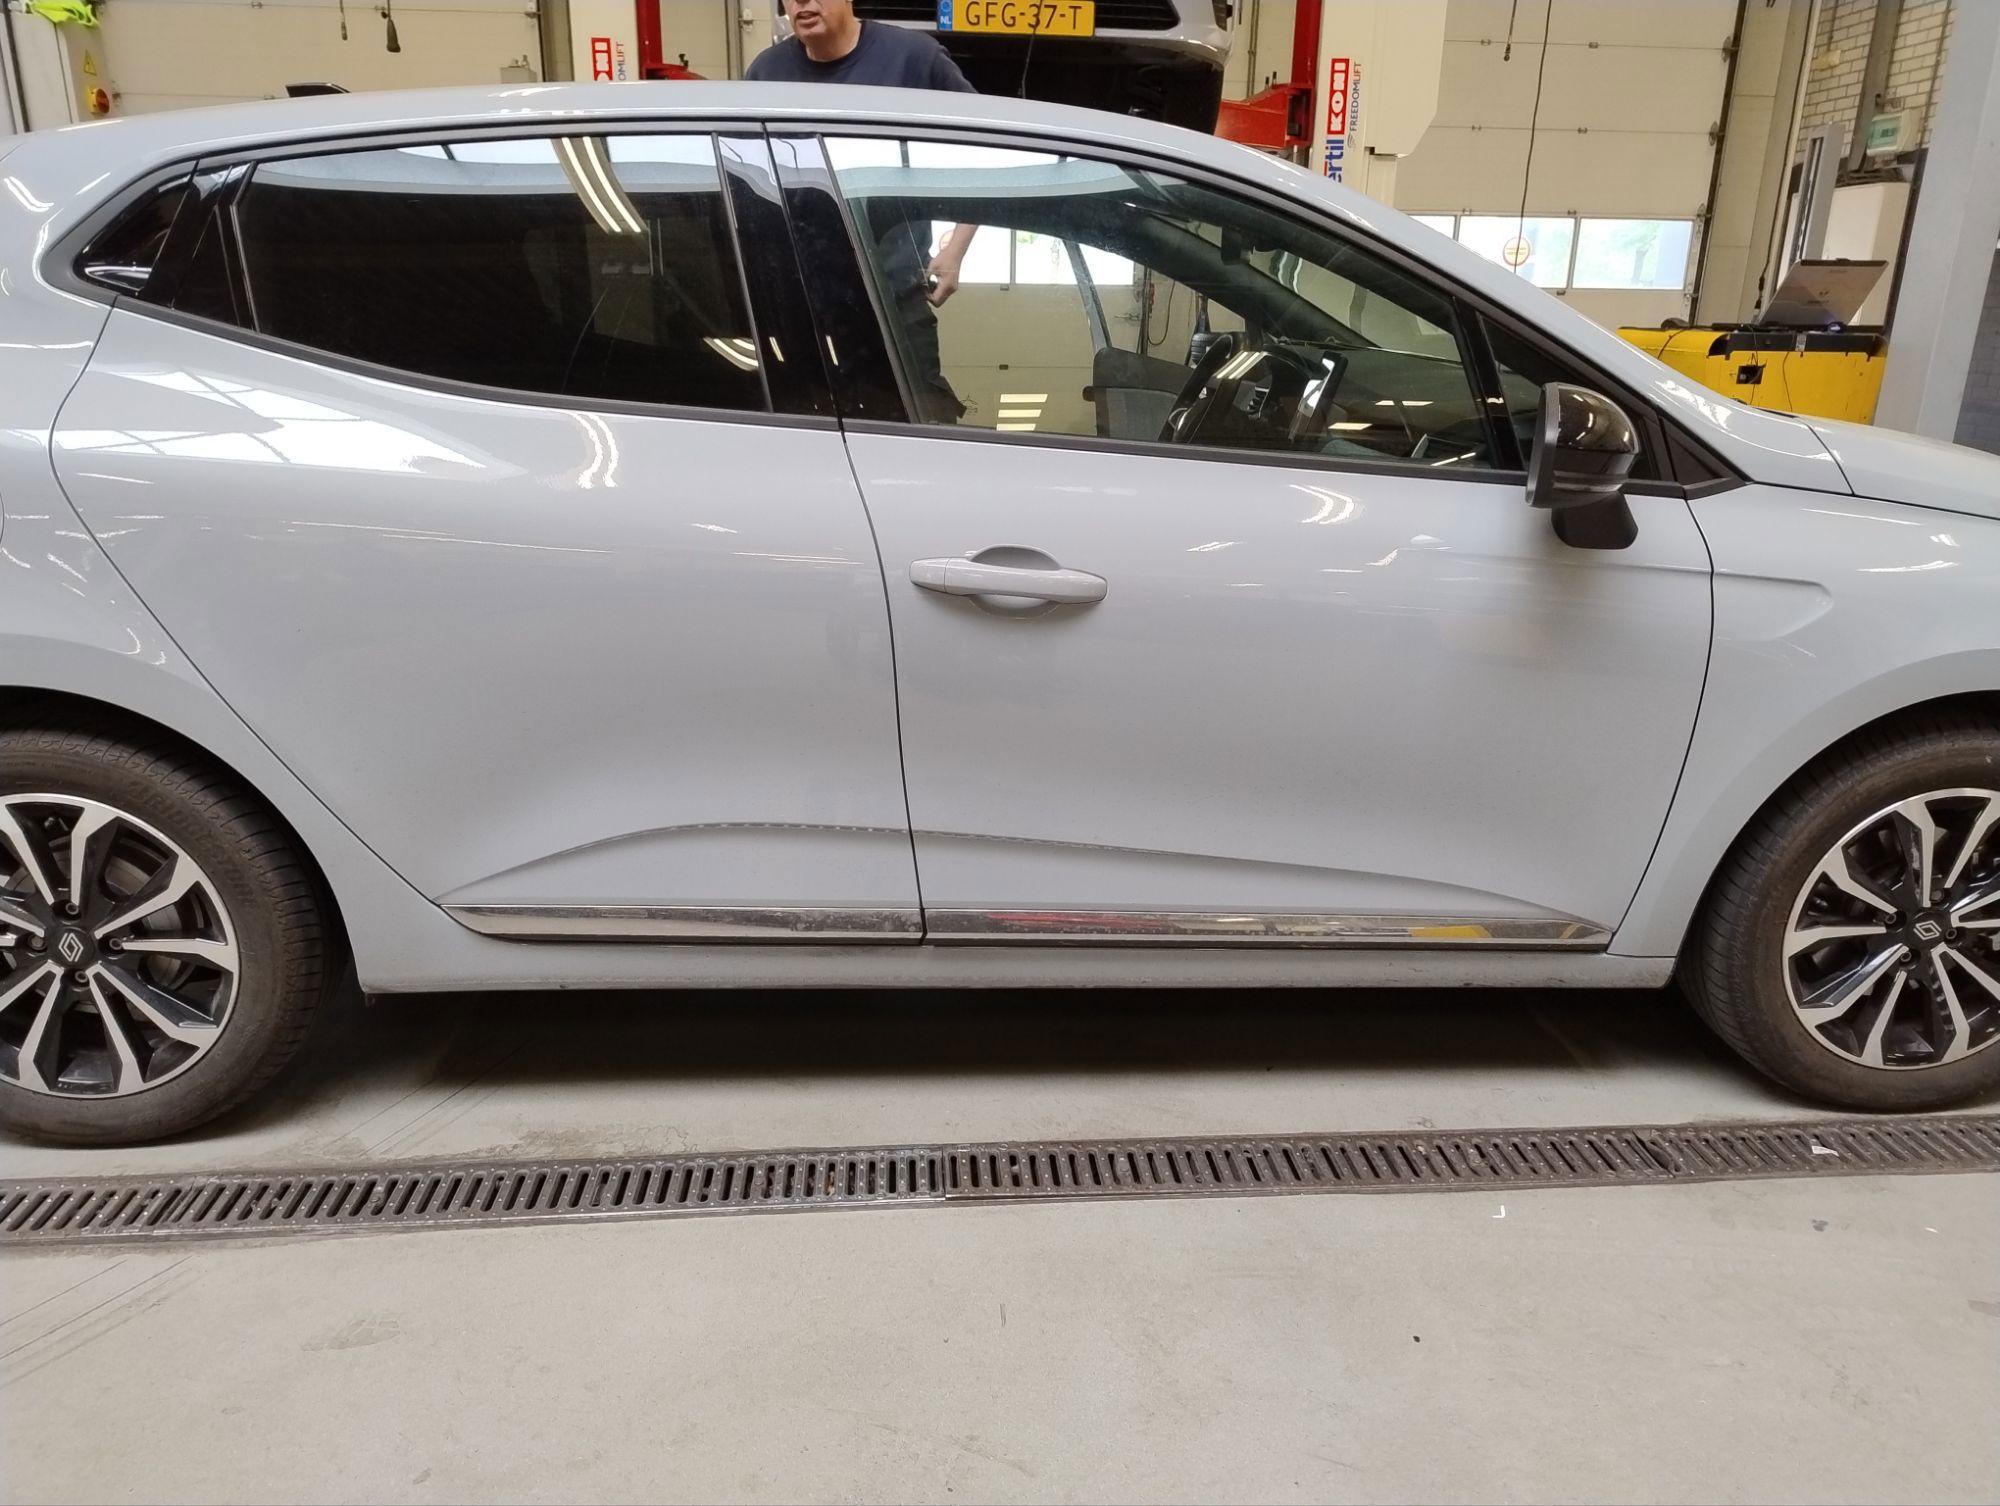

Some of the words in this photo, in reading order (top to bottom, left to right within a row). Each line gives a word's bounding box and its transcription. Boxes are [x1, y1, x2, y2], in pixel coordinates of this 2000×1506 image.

[939, 15, 952, 25] NL
[965, 1, 1083, 30] GFG-37-T
[1329, 60, 1347, 132] KONI
[1350, 61, 1363, 132] FREEDOMLIFT
